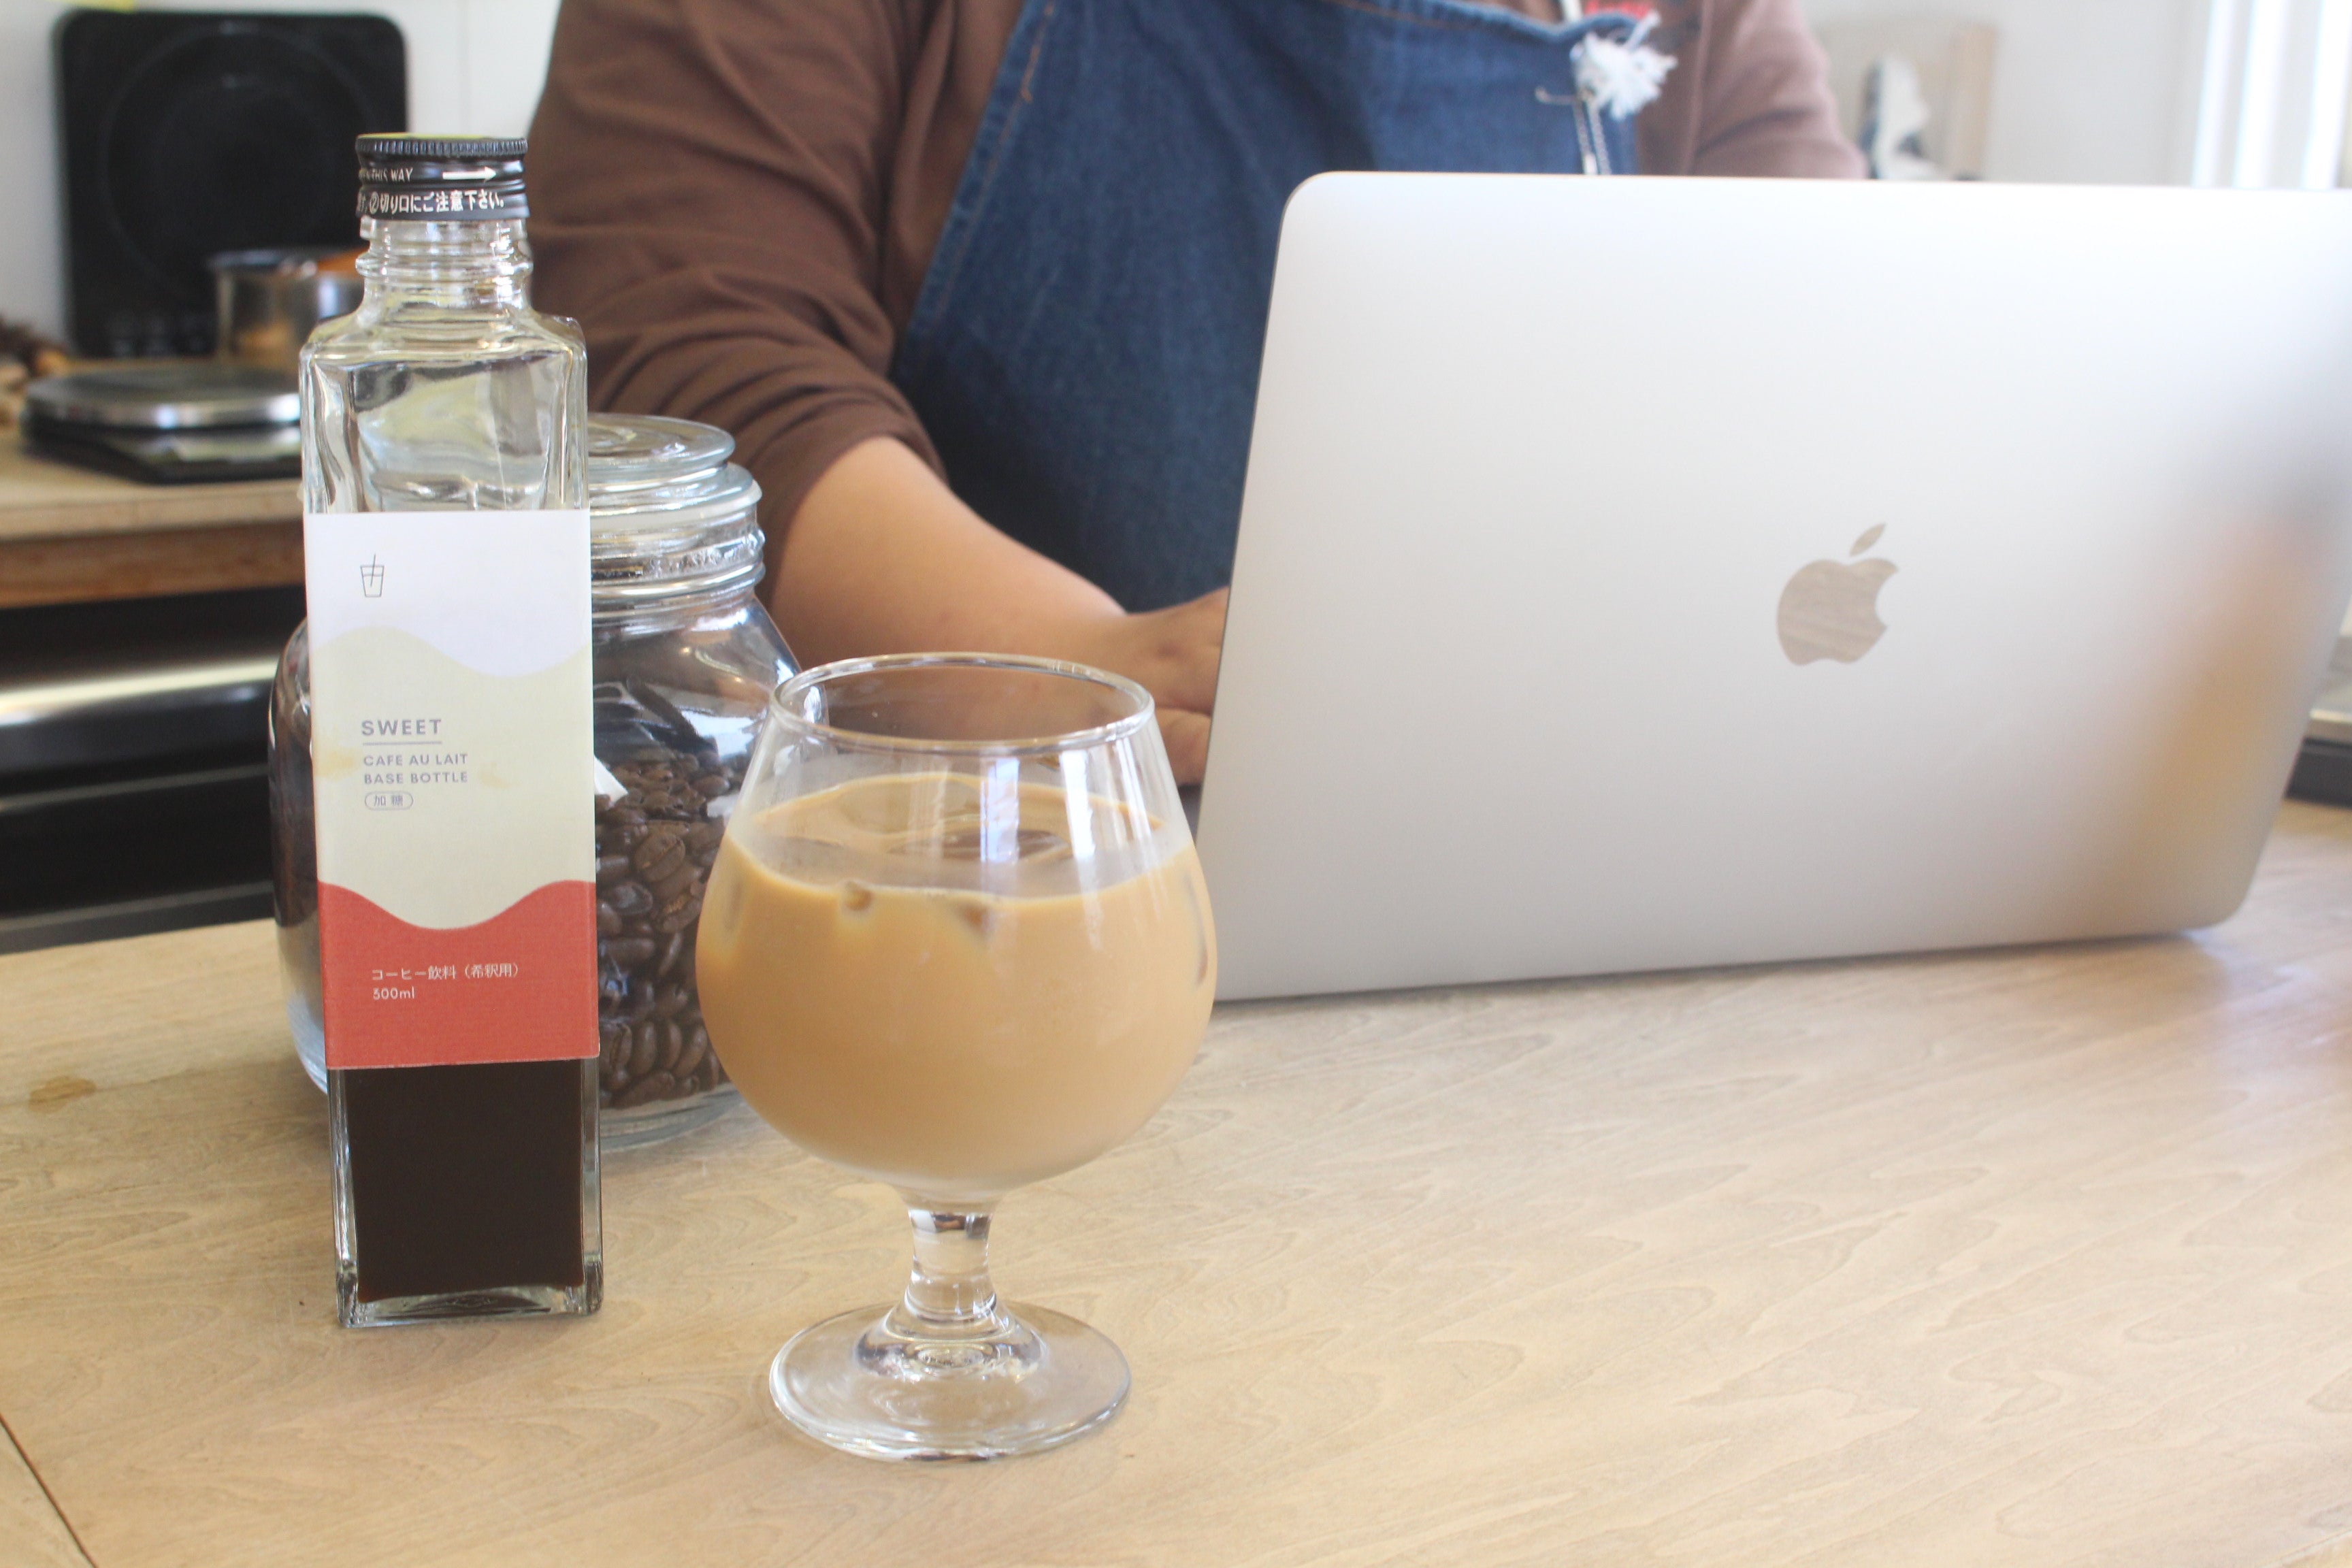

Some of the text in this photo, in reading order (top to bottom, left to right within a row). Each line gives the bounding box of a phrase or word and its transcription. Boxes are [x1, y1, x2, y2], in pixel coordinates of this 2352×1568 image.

[391, 167, 413, 182] WAY
[361, 719, 442, 736] SWEET
[363, 753, 468, 766] CAFE AU LAIT
[363, 771, 468, 785] BASE BOTTLE
